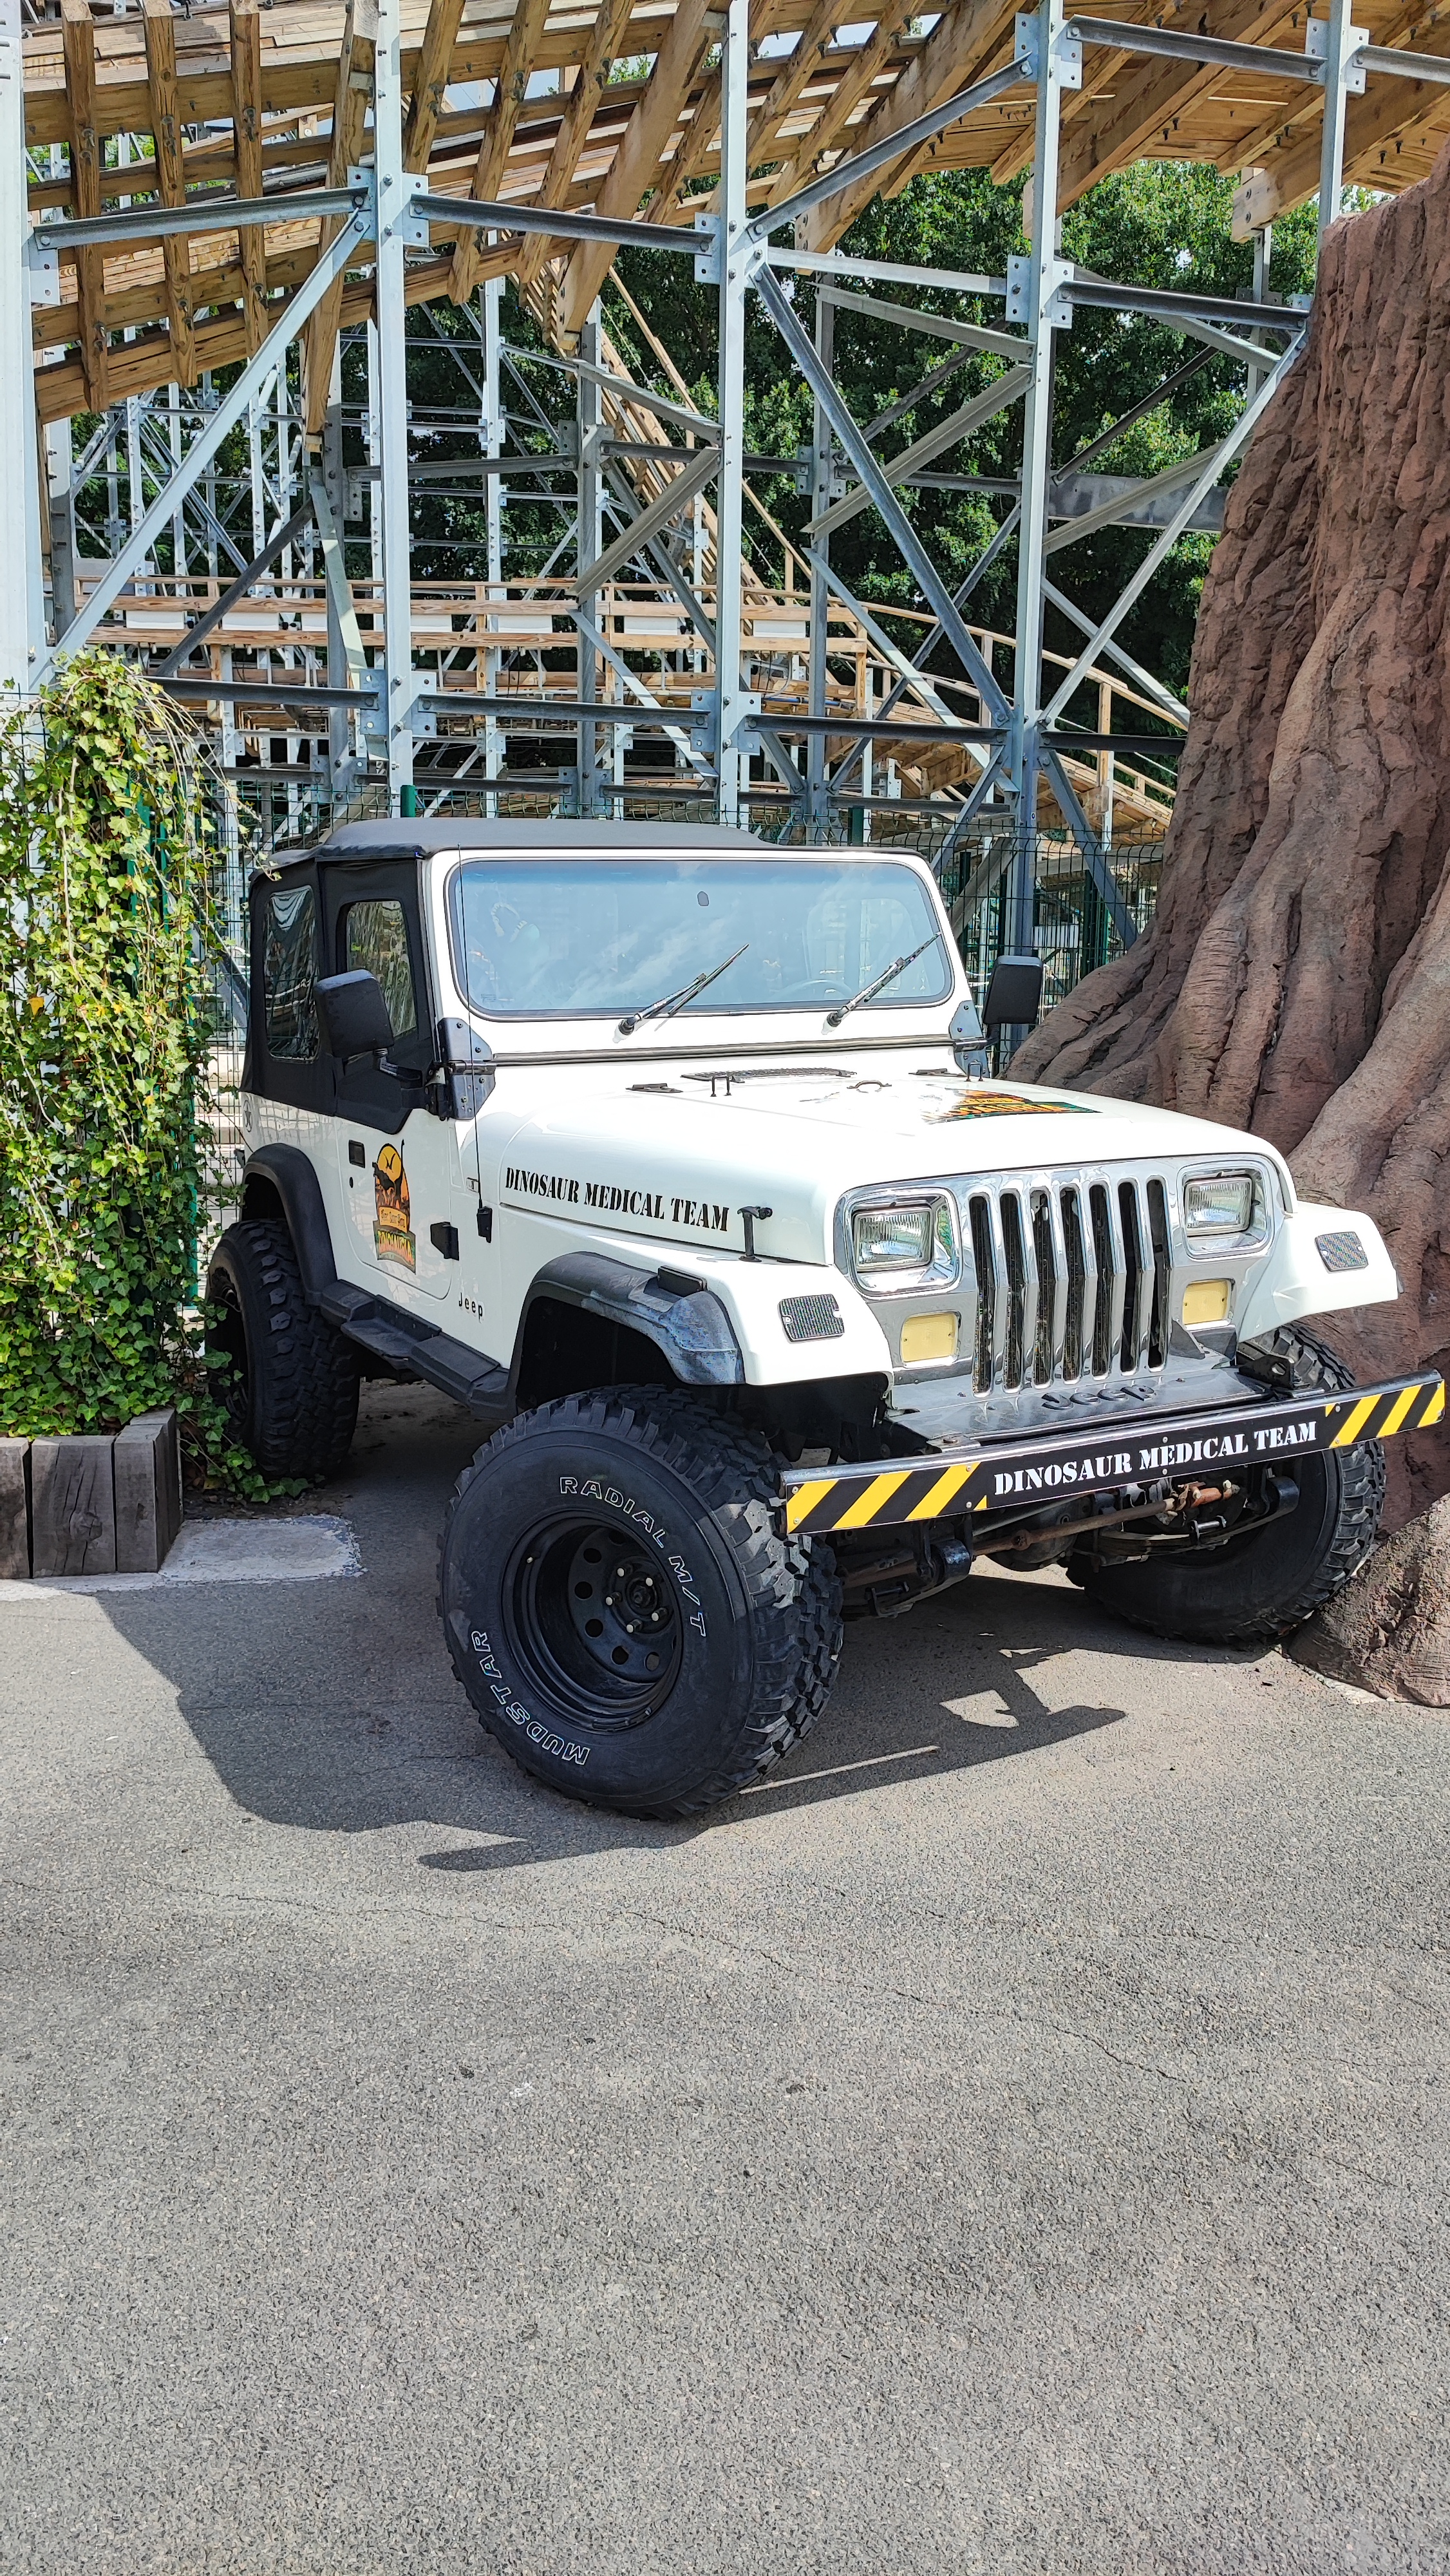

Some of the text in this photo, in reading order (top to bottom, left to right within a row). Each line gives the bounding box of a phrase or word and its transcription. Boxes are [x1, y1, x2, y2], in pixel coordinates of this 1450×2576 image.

[505, 1167, 730, 1232] DINOSAUR MEDICAL TEAM
[458, 1292, 483, 1322] Jeep
[1041, 1385, 1156, 1410] Jeep
[993, 1421, 1317, 1496] DINOSAUR MEDICAL TEAM
[560, 1477, 706, 1637] RADIAL M/T
[471, 1630, 590, 1765] MUDSTAR
